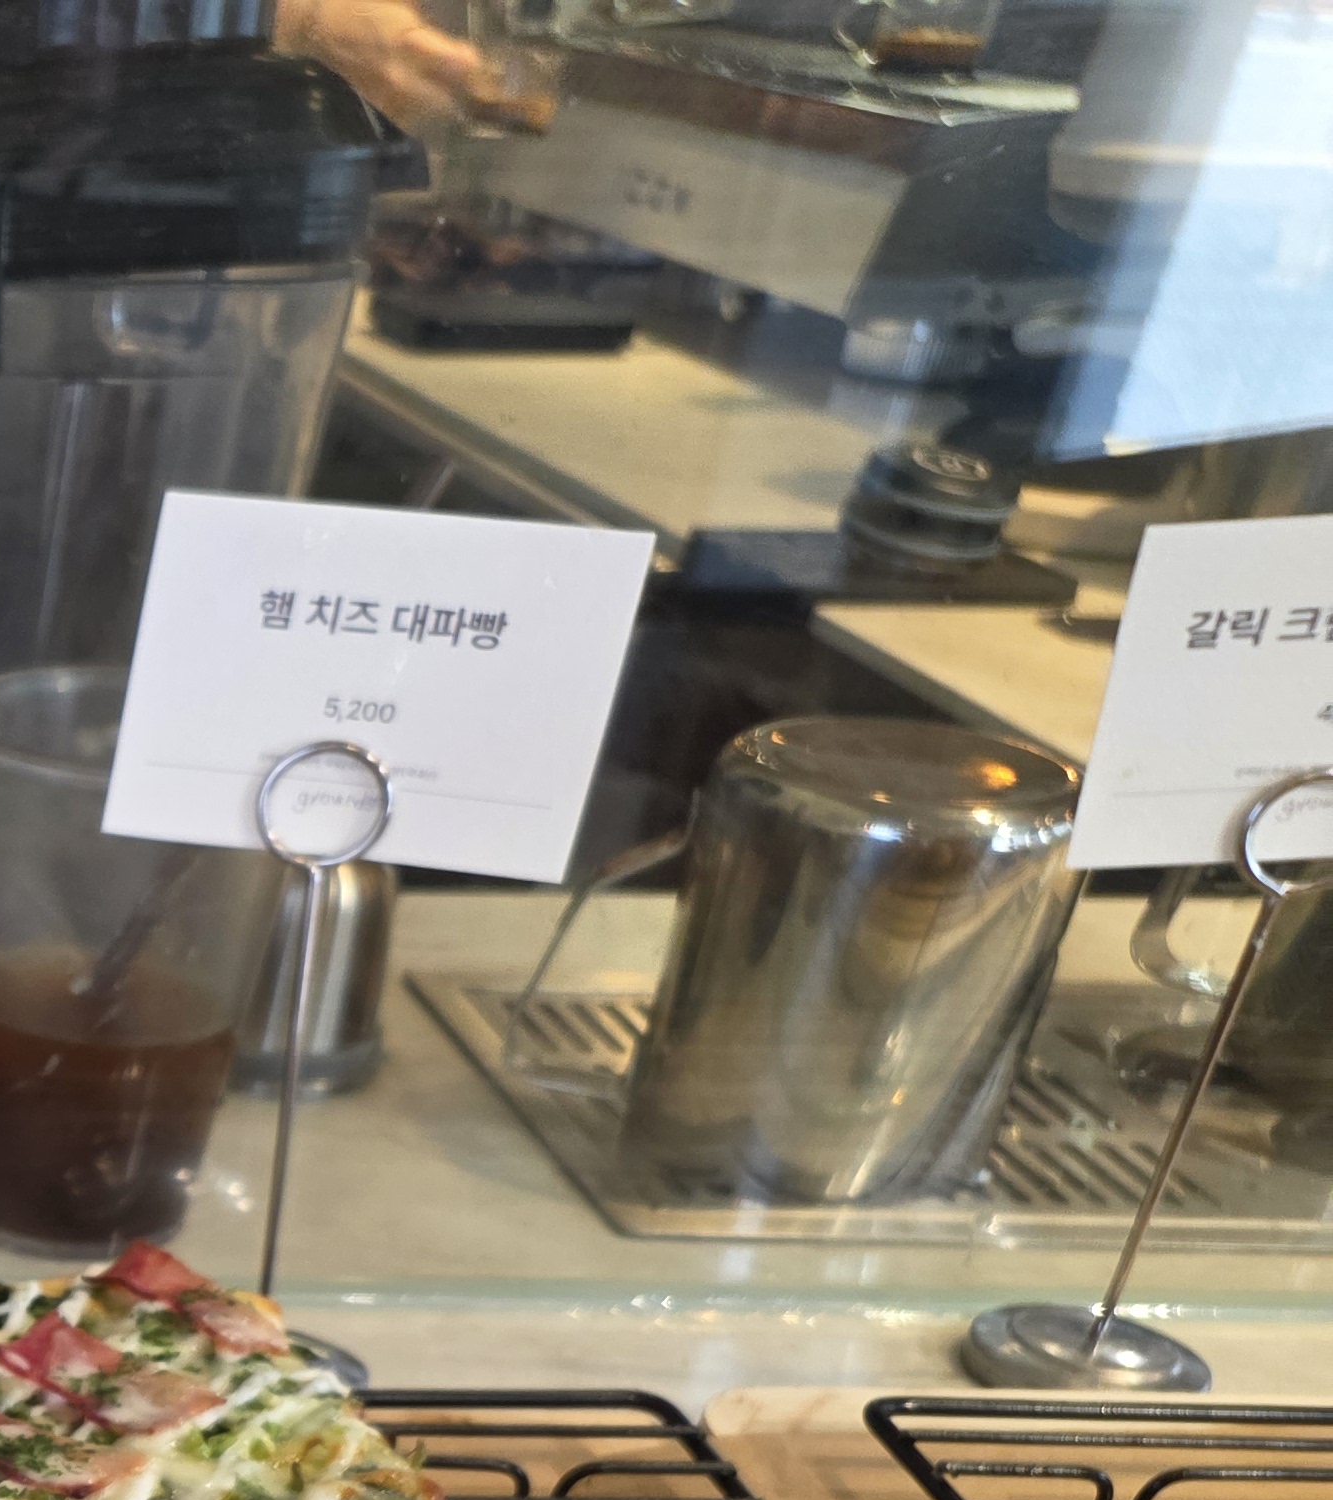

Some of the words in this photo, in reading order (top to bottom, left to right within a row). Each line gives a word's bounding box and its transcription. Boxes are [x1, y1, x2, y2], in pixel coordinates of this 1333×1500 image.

[259, 589, 296, 631] 햄
[304, 595, 379, 635] 치즈
[390, 603, 509, 652] 대파빵
[1185, 606, 1269, 650] 갈릭
[322, 696, 397, 725] 5,200
